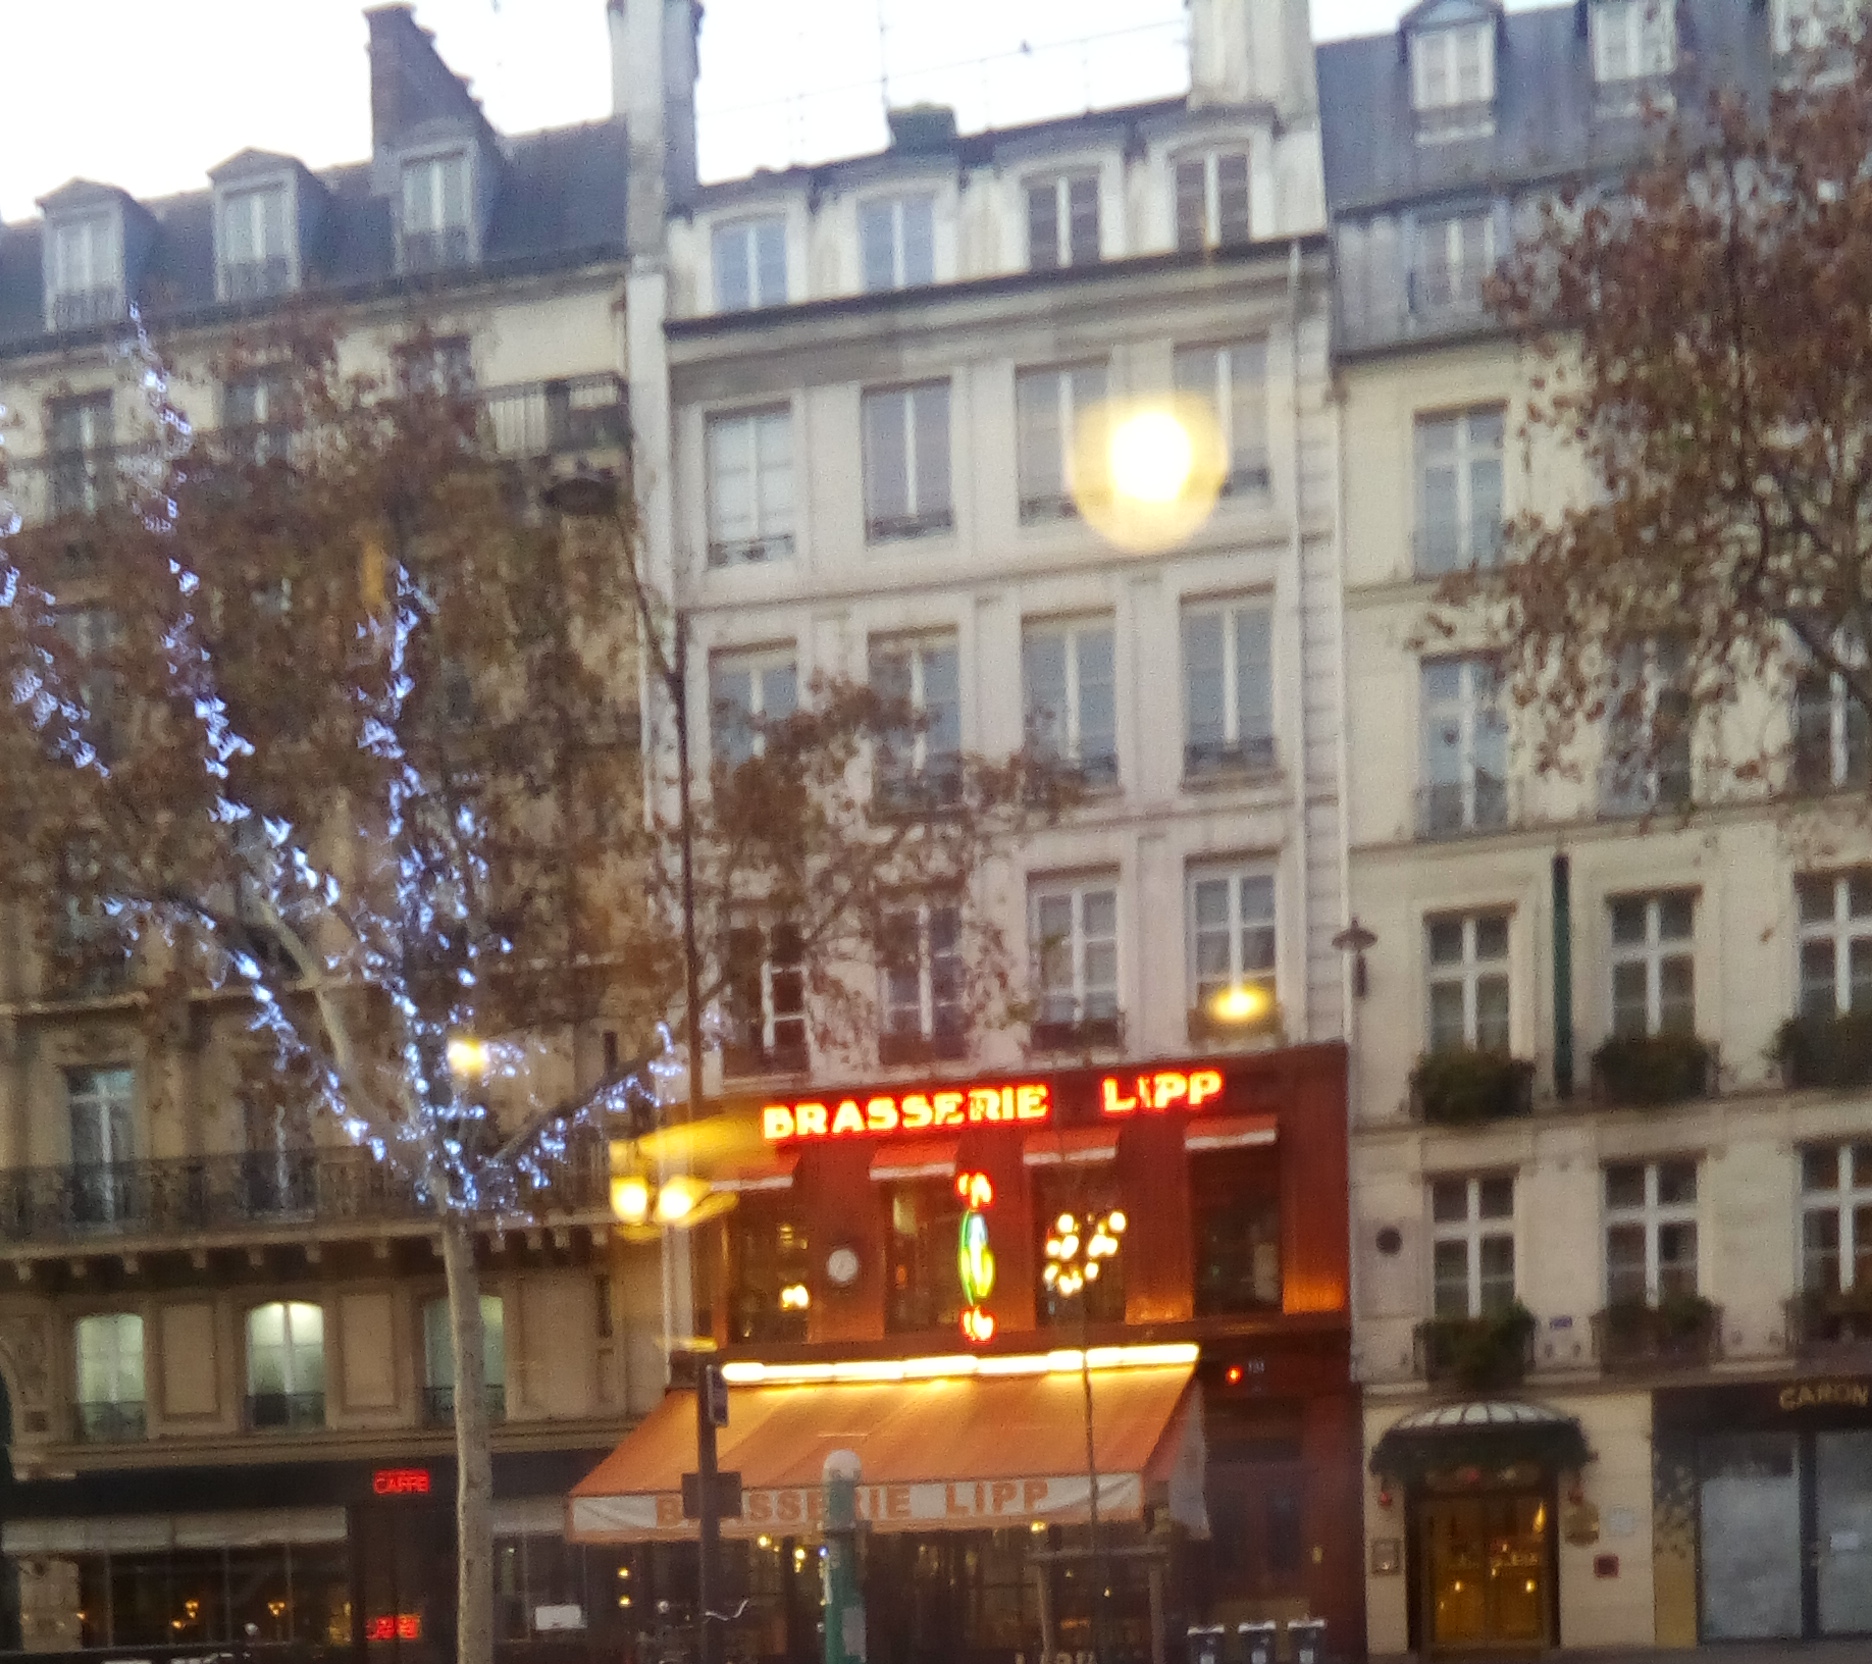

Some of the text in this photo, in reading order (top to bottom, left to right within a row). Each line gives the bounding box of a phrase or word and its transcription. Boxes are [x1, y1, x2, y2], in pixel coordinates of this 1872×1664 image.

[762, 1070, 1223, 1141] BRASSERIE LIPP
[946, 1478, 1049, 1518] LIPP
